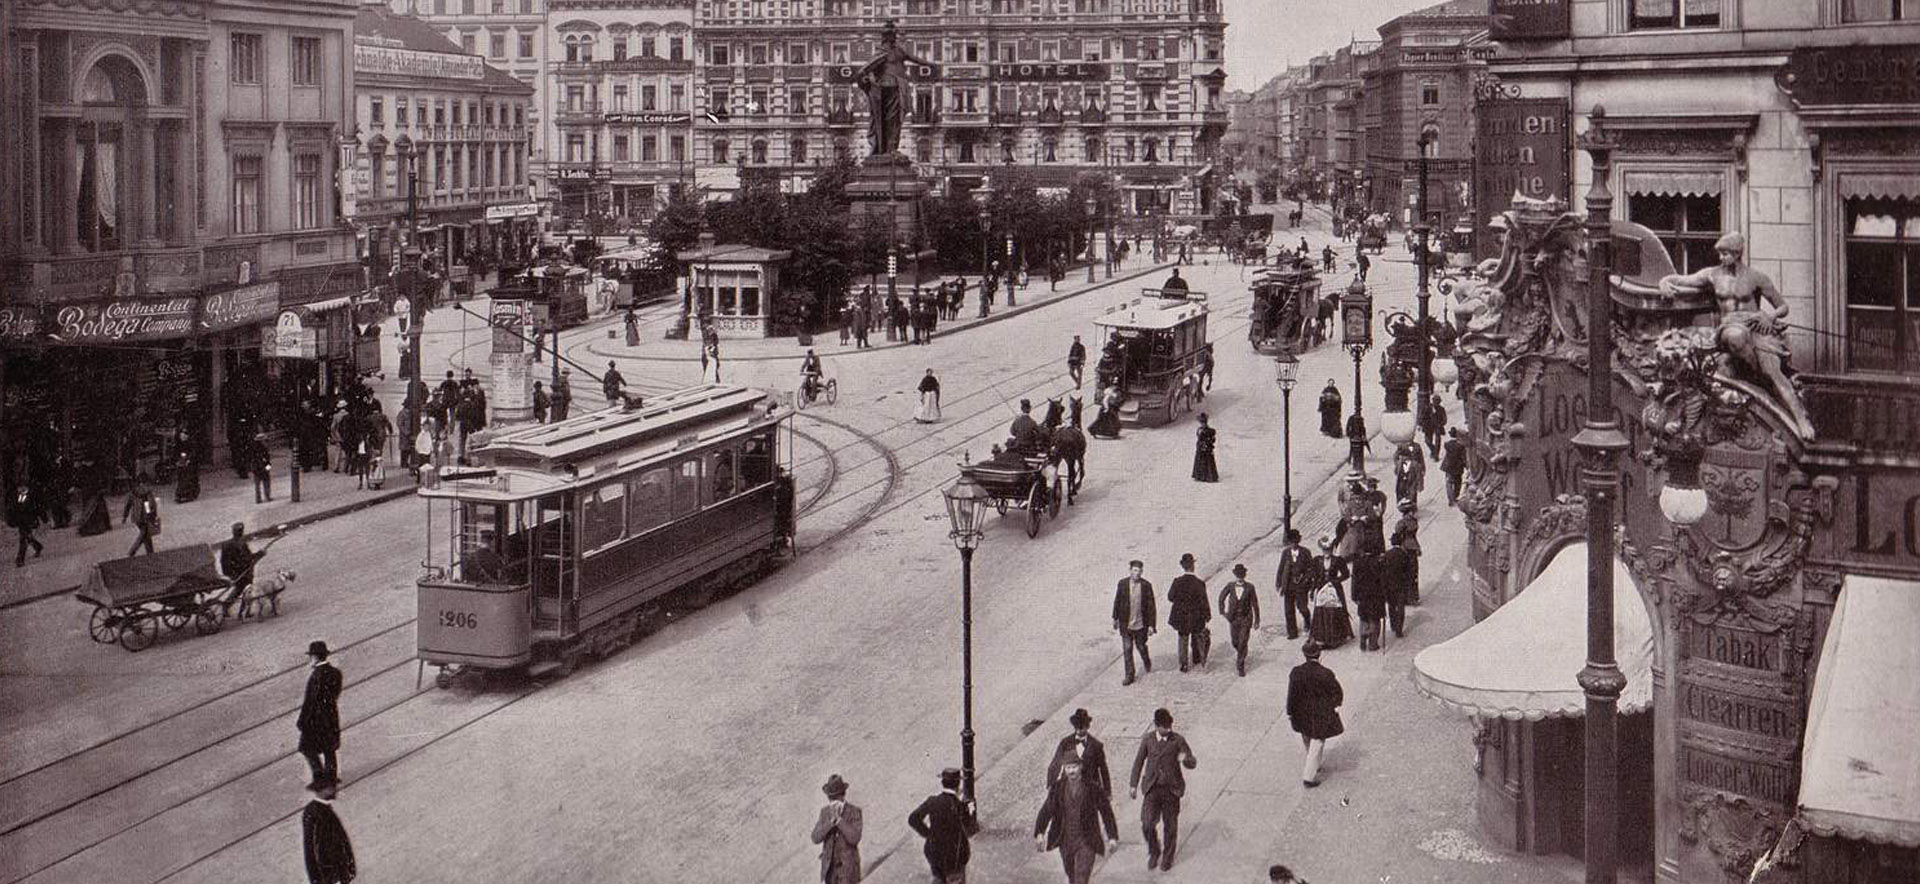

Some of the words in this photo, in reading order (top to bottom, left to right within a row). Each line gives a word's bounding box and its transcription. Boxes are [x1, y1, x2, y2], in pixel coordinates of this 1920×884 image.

[1000, 64, 1088, 76] HOTEL
[106, 299, 191, 318] Continental
[49, 305, 141, 342] Bodega
[439, 610, 478, 630] 1206
[1702, 627, 1771, 671] Tabak
